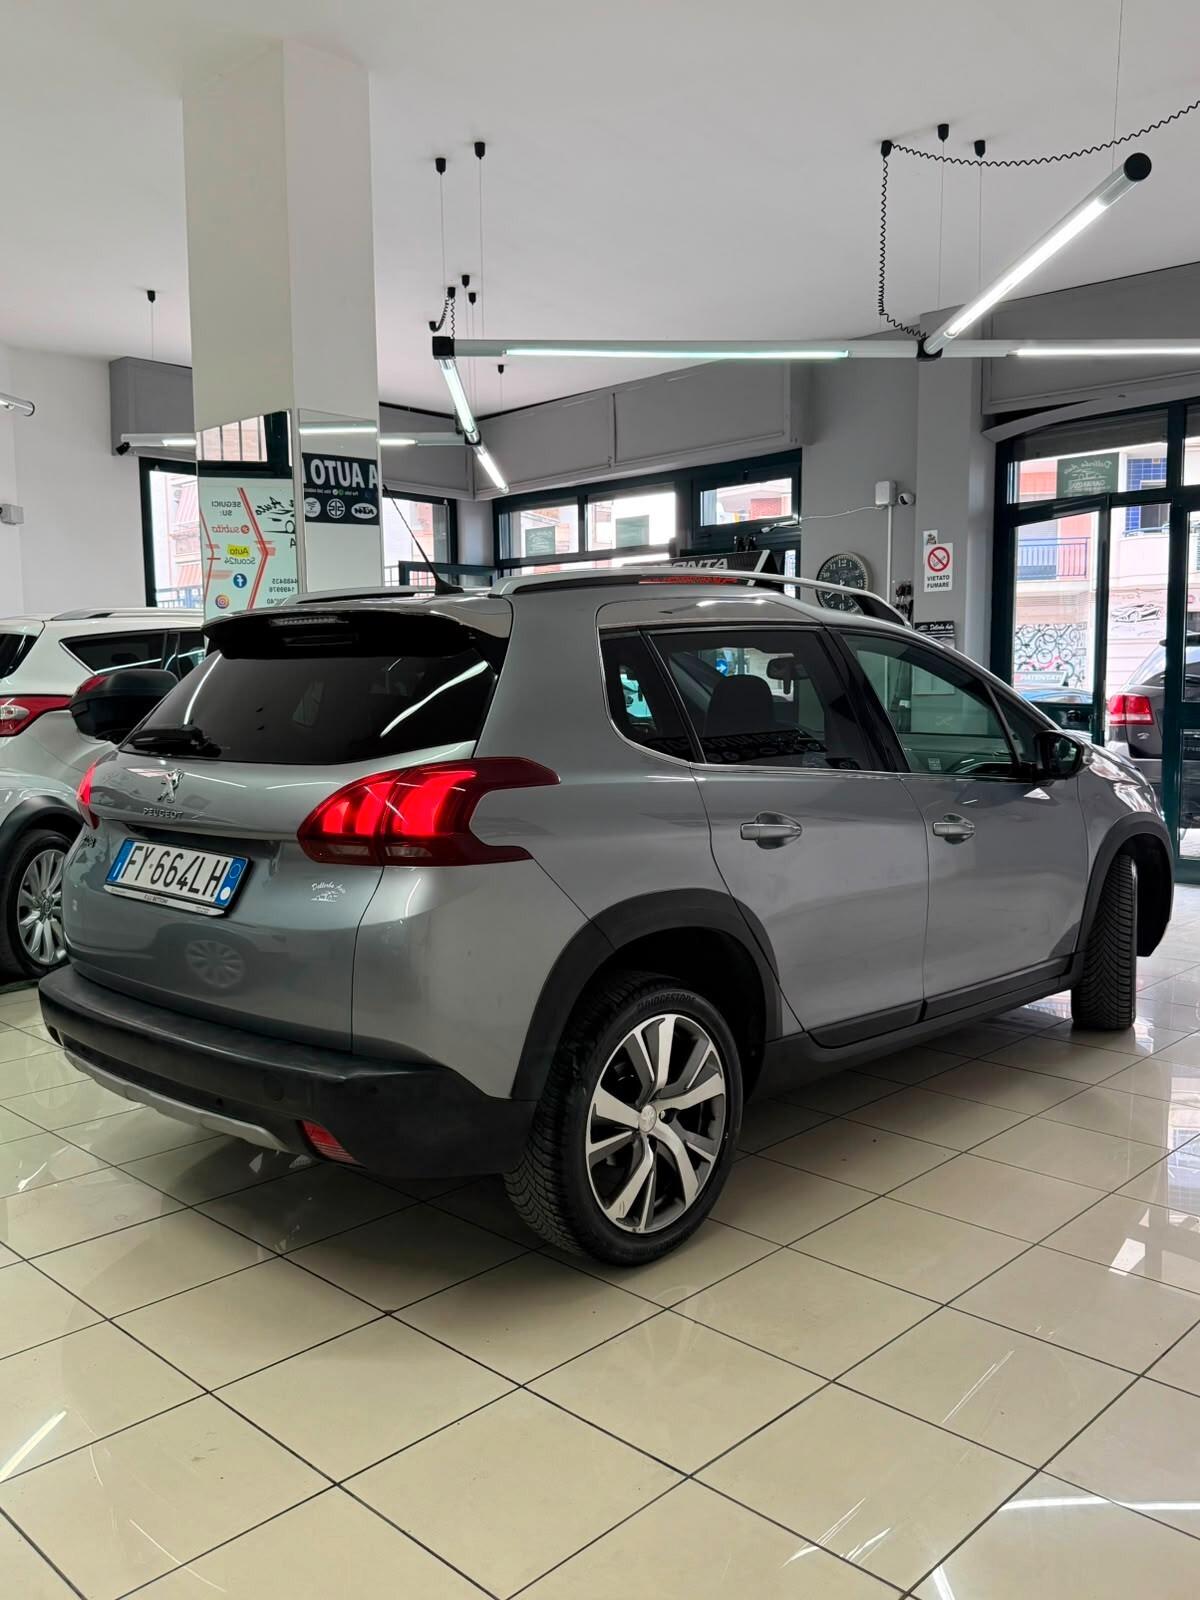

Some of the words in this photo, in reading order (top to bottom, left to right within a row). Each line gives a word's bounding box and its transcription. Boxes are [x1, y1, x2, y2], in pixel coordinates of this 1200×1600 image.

[143, 807, 184, 819] PEUGEOT
[121, 845, 155, 880] FY
[150, 850, 228, 898] 664LH
